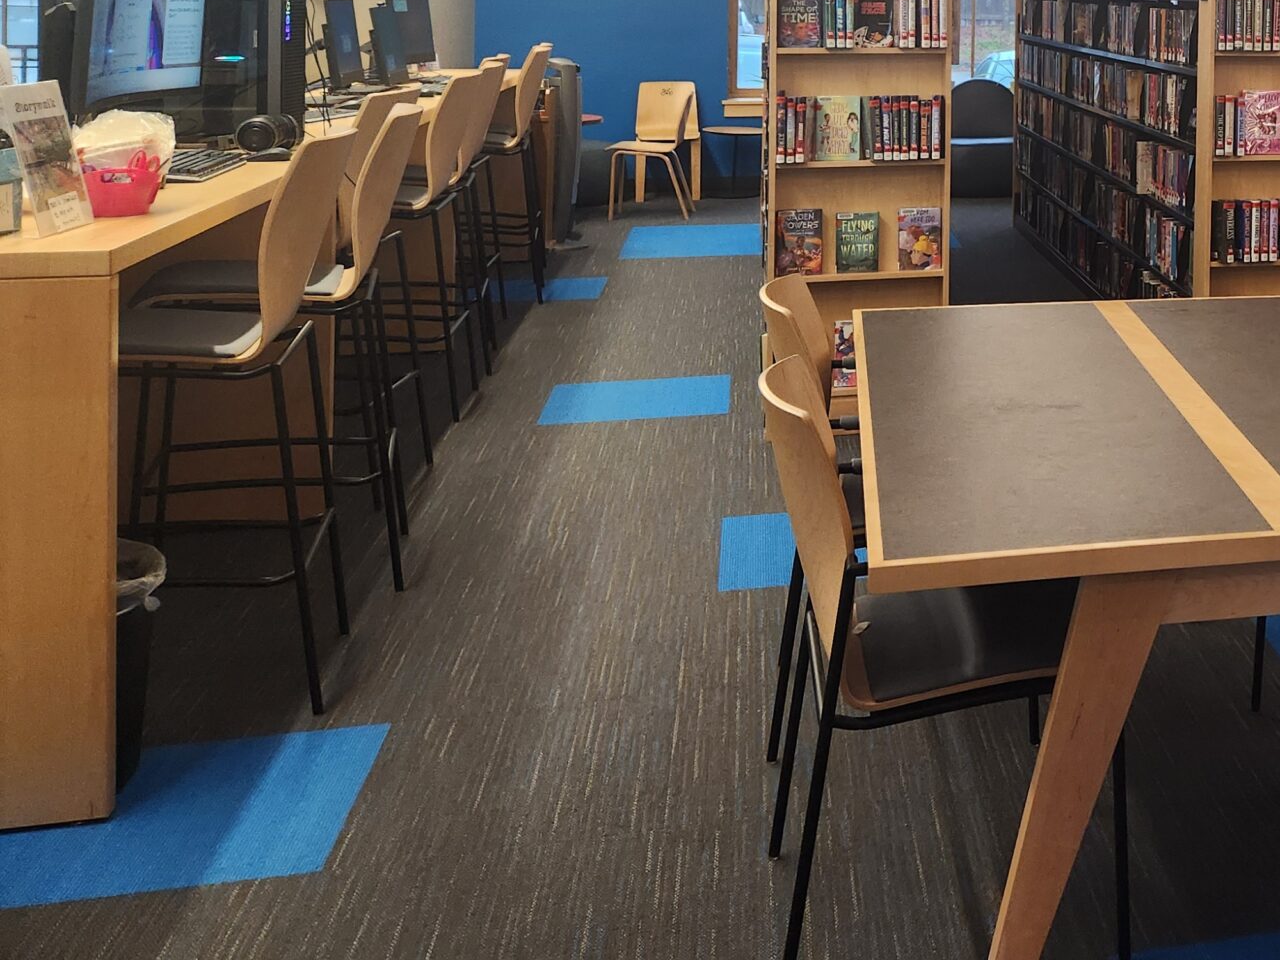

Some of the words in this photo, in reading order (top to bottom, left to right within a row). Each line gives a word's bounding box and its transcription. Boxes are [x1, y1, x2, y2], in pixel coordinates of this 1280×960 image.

[781, 13, 817, 24] TIME
[786, 220, 819, 230] OWERS
[842, 220, 875, 232] FLYING
[840, 243, 875, 257] WATER
